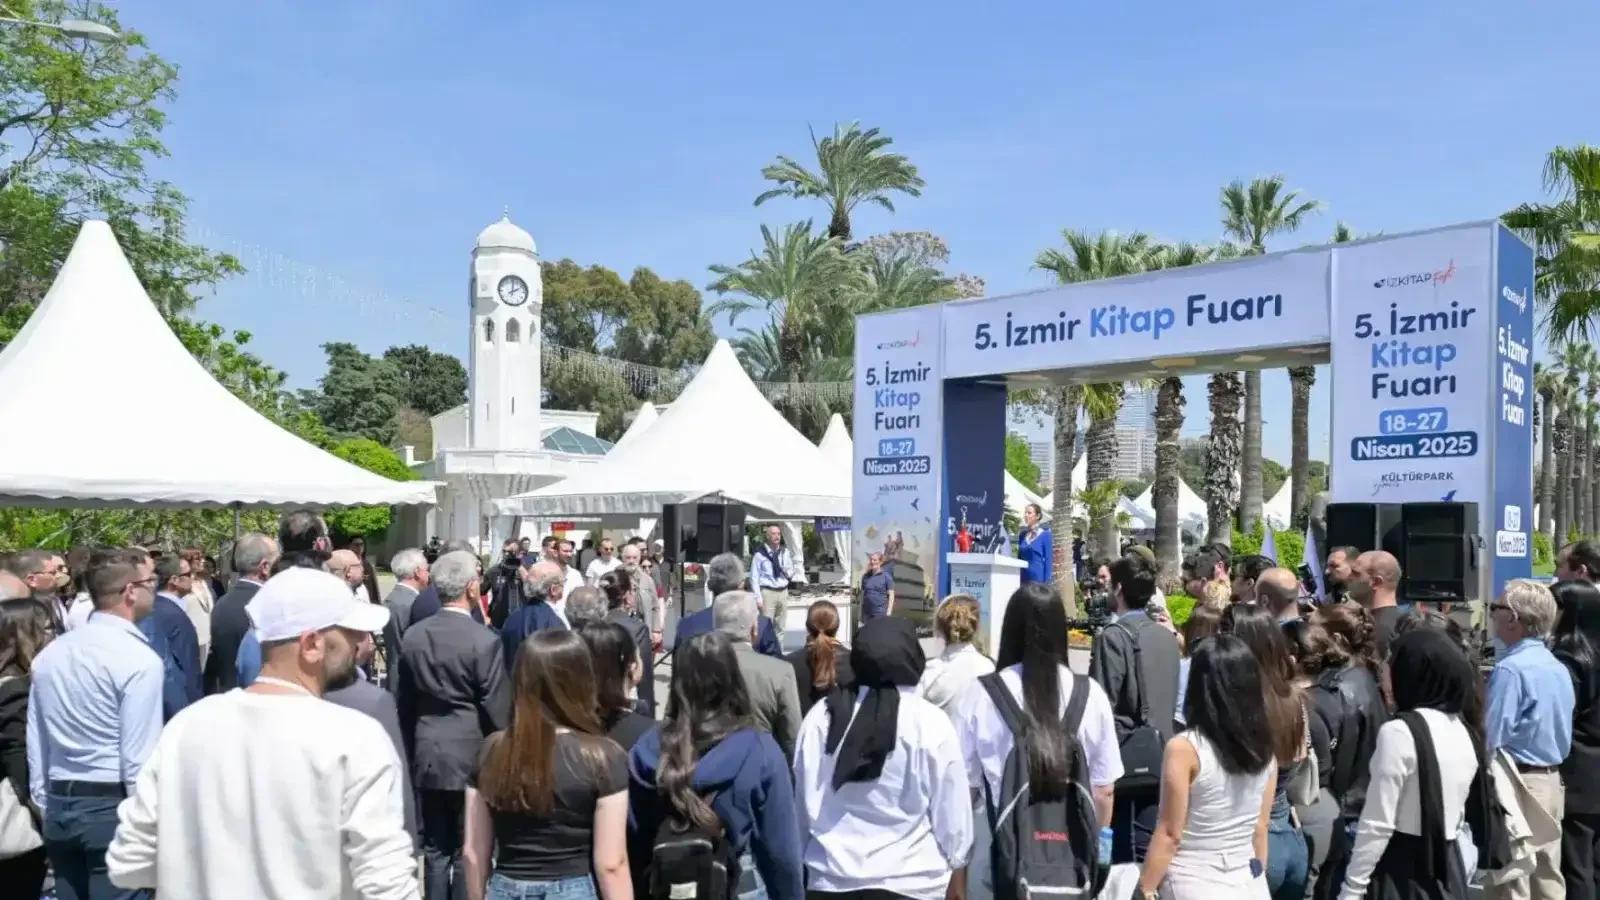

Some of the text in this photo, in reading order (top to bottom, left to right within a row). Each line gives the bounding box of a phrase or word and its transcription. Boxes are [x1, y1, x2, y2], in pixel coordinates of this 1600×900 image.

[975, 294, 1282, 350] 5. İzmir Kitap Fuarı
[1355, 301, 1476, 339] 5. İzmir
[1371, 340, 1457, 371] Kitap
[866, 360, 931, 386] 5. İzmir
[1371, 372, 1457, 399] Fuarı
[875, 387, 921, 411] Kitap
[875, 412, 920, 431] Fuarı
[1384, 411, 1443, 432] 18-27
[881, 441, 912, 456] 18-27
[1357, 435, 1473, 459] Nisan 2025
[866, 459, 928, 474] Nisan 2025
[1381, 471, 1454, 482] KÜLTÜRPARK
